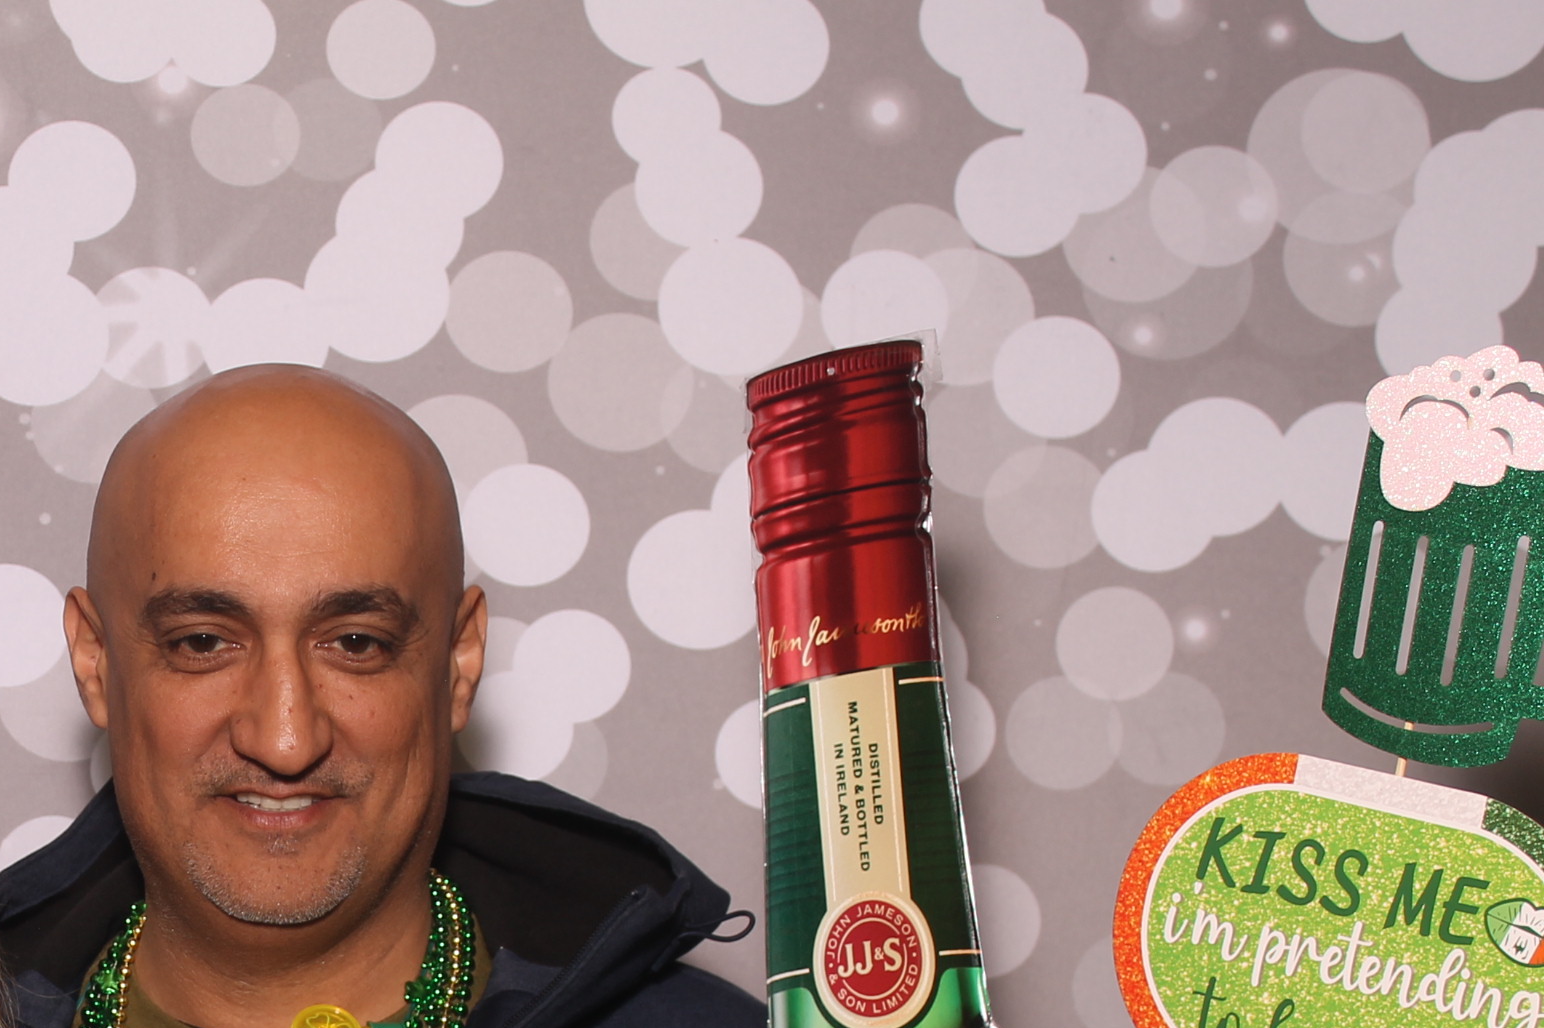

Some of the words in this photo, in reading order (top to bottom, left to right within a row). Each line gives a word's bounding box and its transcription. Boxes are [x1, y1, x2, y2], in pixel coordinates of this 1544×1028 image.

[767, 626, 802, 679] John
[834, 743, 845, 760] IN
[848, 701, 863, 779] MATURED
[836, 764, 850, 836] IRELAND
[854, 784, 864, 795] &
[868, 743, 884, 825] DISTILLED
[855, 798, 871, 872] BOTTLED
[1195, 817, 1369, 917] KISS
[1383, 862, 1491, 945] ME
[826, 914, 851, 959] JOHN
[856, 903, 917, 948] JAMESON
[1163, 881, 1245, 962] i'm
[837, 937, 903, 978] JJ&S
[837, 988, 866, 1013] SON
[872, 964, 918, 1014] LIMITED
